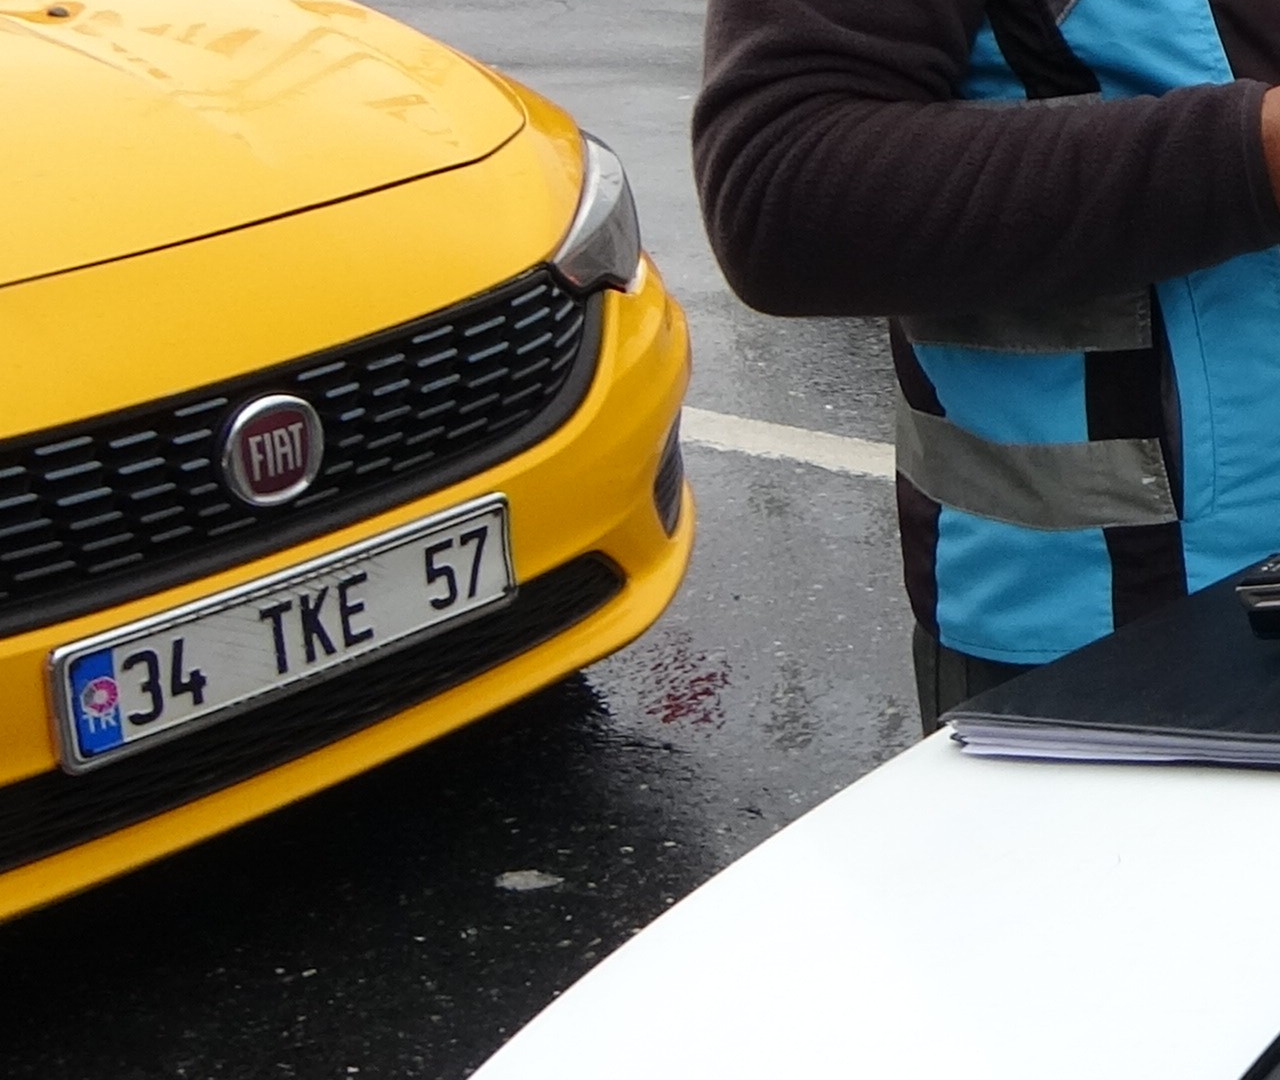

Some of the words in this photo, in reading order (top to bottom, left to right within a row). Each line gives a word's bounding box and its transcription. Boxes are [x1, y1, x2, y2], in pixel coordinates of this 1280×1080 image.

[247, 421, 304, 483] FIAT
[120, 637, 207, 728] 34
[258, 572, 375, 676] TKE
[423, 525, 489, 611] 57
